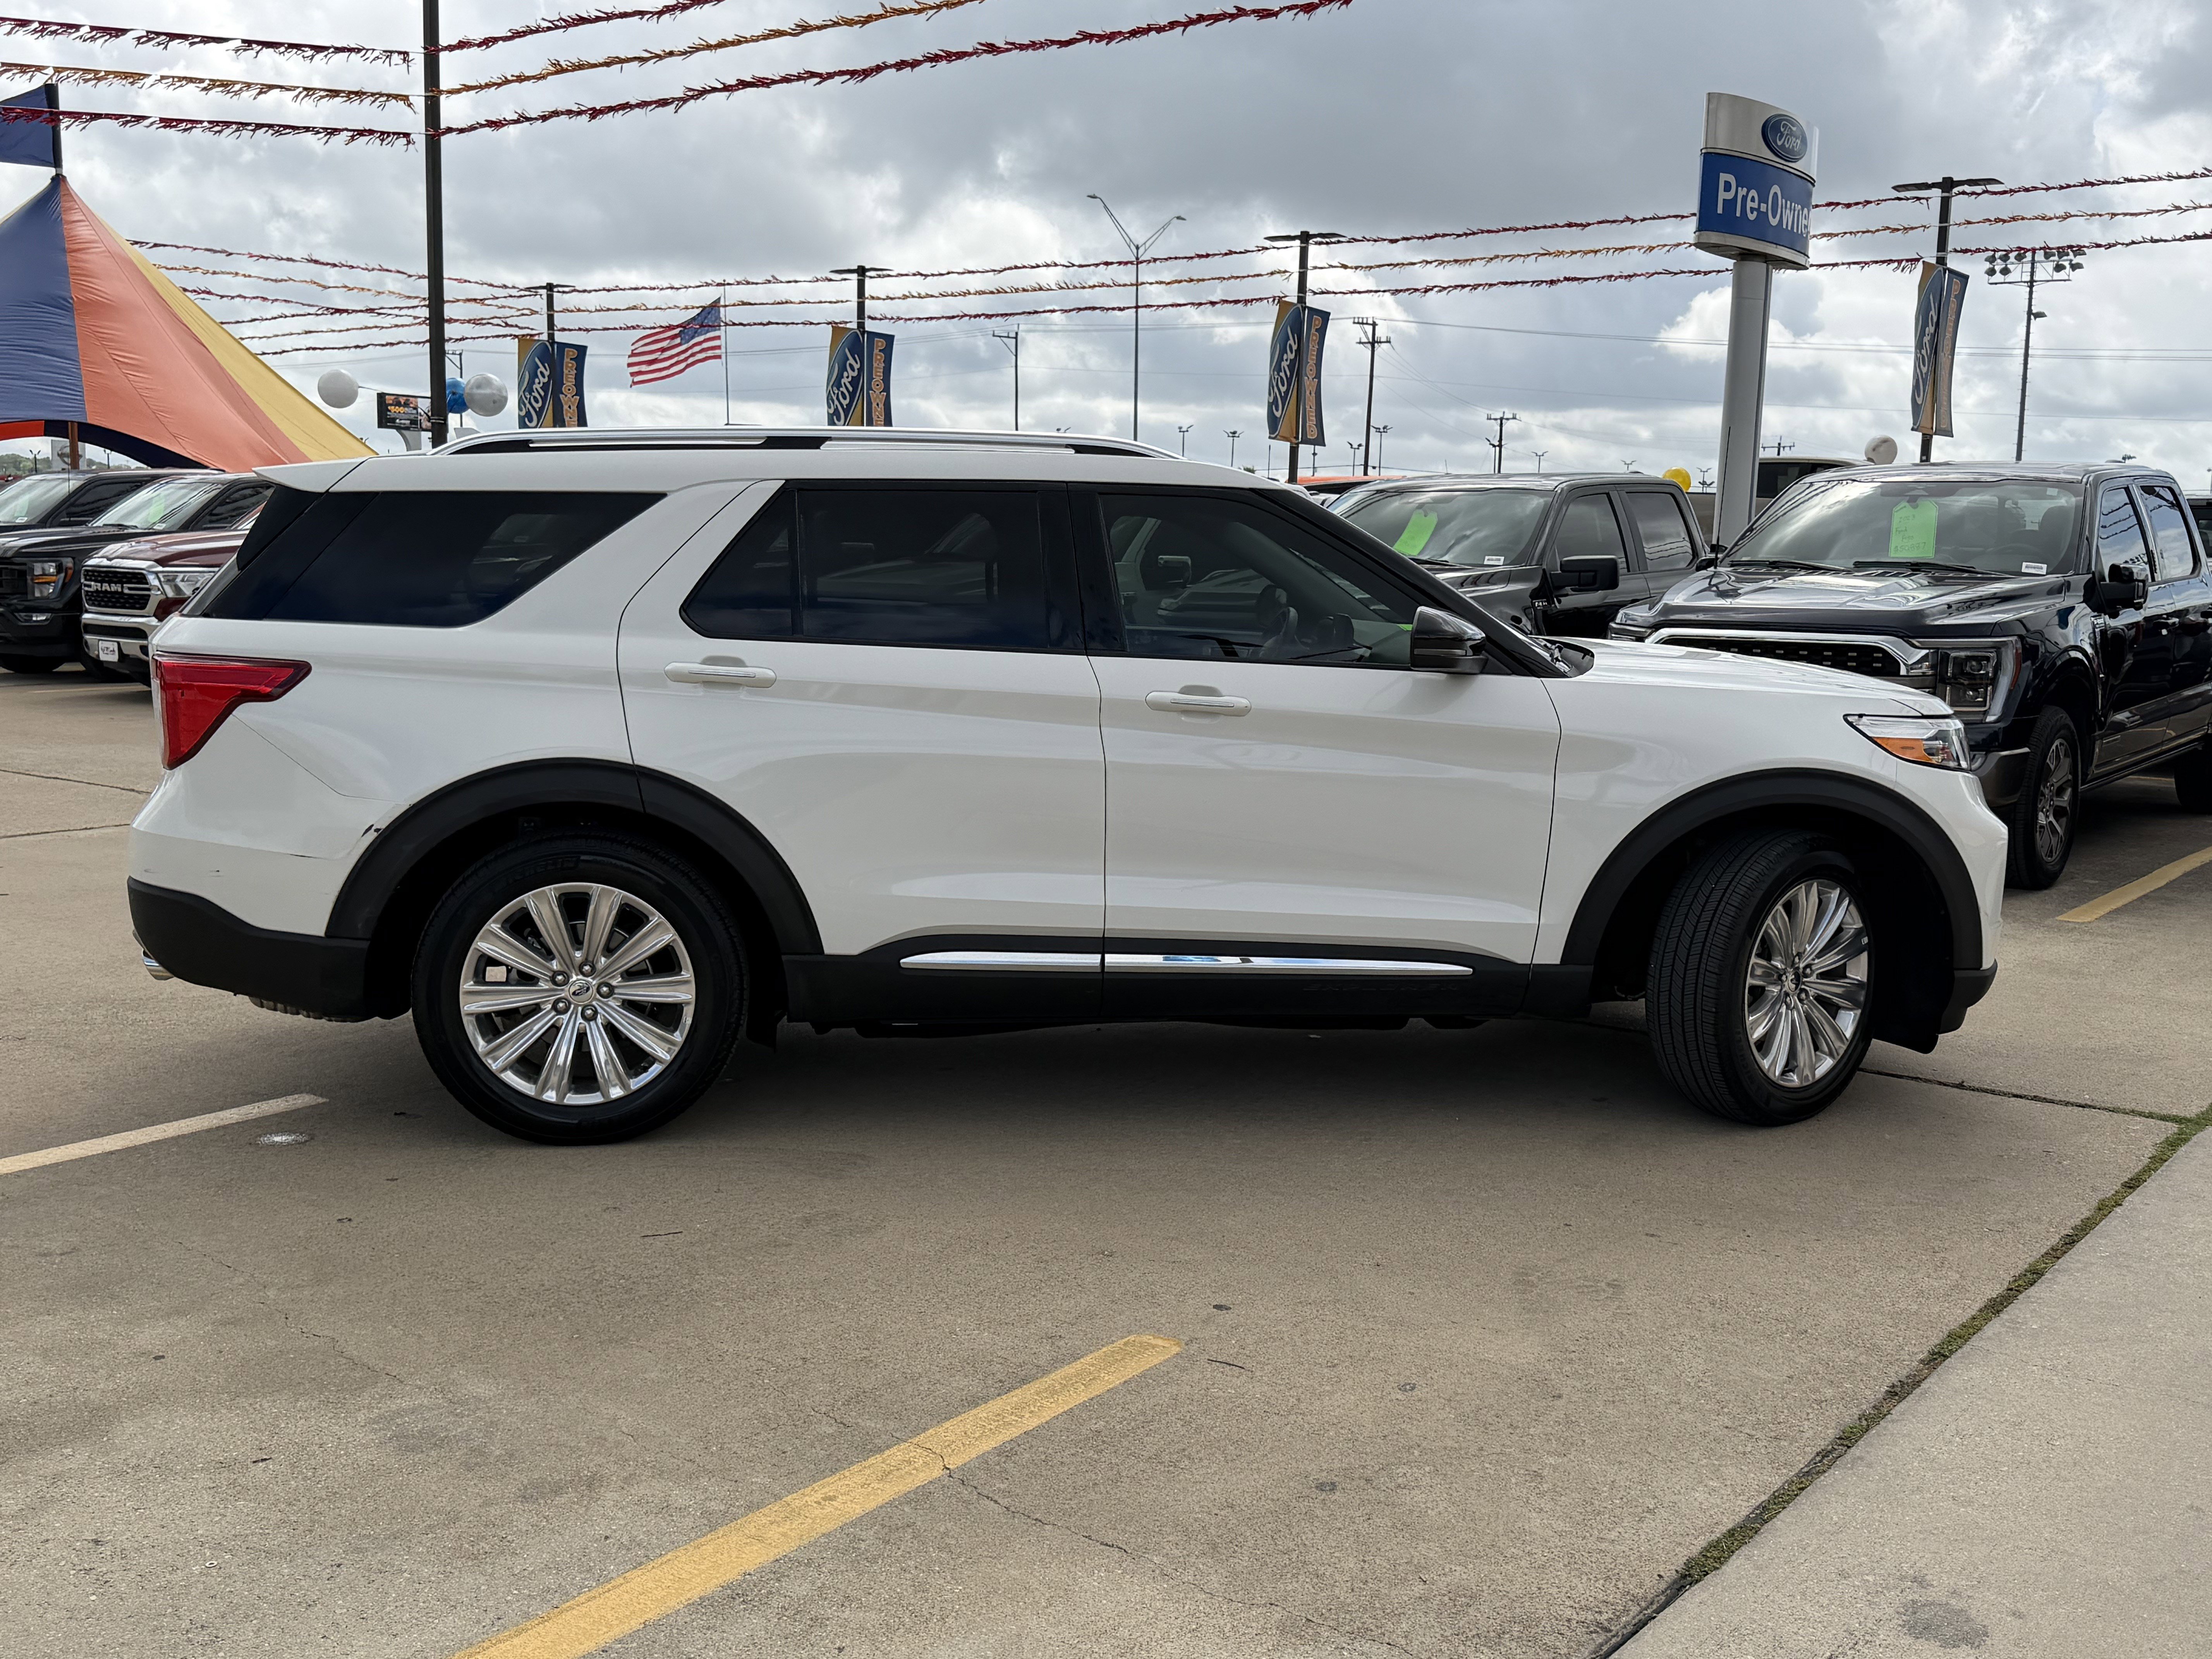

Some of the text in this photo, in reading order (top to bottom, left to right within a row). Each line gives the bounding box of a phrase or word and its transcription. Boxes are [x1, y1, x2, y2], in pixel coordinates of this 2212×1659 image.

[1777, 121, 1802, 152] Ford
[559, 348, 580, 428] PREOWNE
[826, 348, 861, 426] Ford
[869, 338, 886, 427] PREOWNE
[1268, 325, 1298, 418] Ford
[1913, 292, 1938, 405] Ford
[518, 356, 550, 427] Ford
[94, 582, 122, 592] RAM
